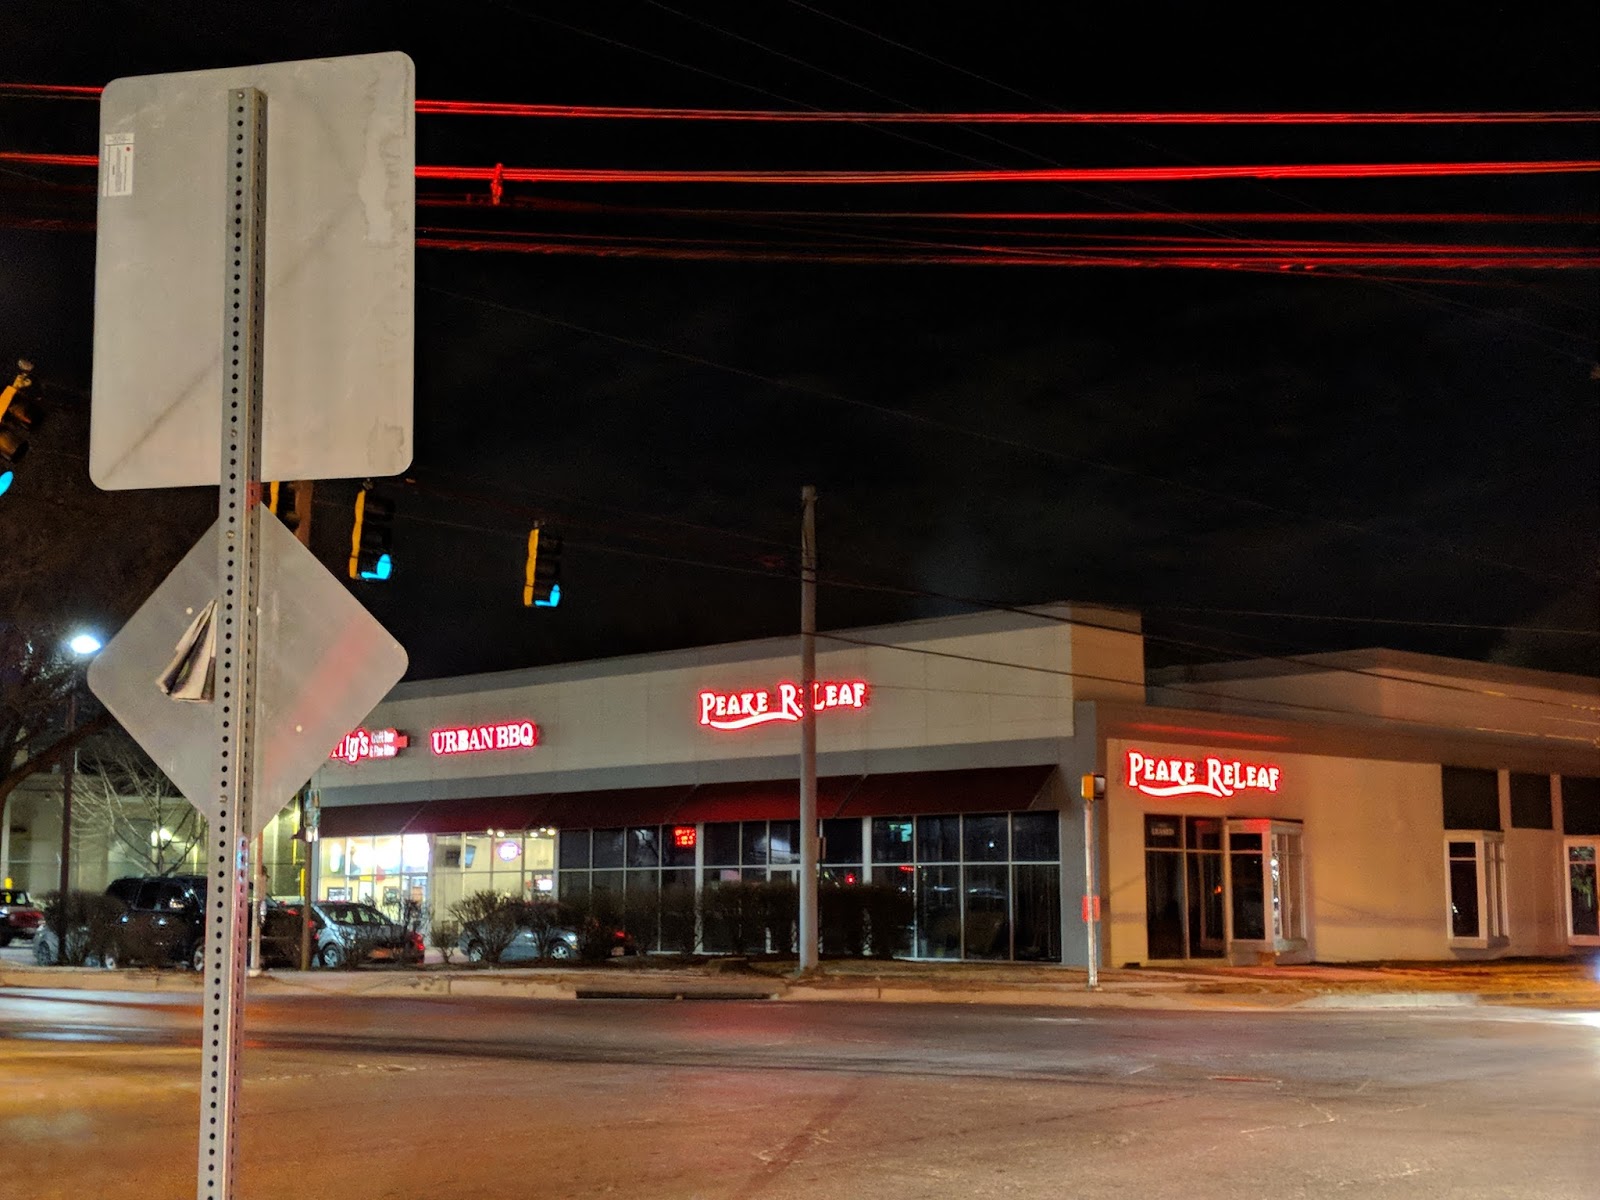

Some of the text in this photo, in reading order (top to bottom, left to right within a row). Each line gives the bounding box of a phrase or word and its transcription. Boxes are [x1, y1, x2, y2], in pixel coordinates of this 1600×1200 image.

[700, 683, 866, 725] PEAKE RLEAF
[432, 722, 534, 754] URBAN BBQ
[1128, 752, 1280, 797] PEAKE RELEAF
